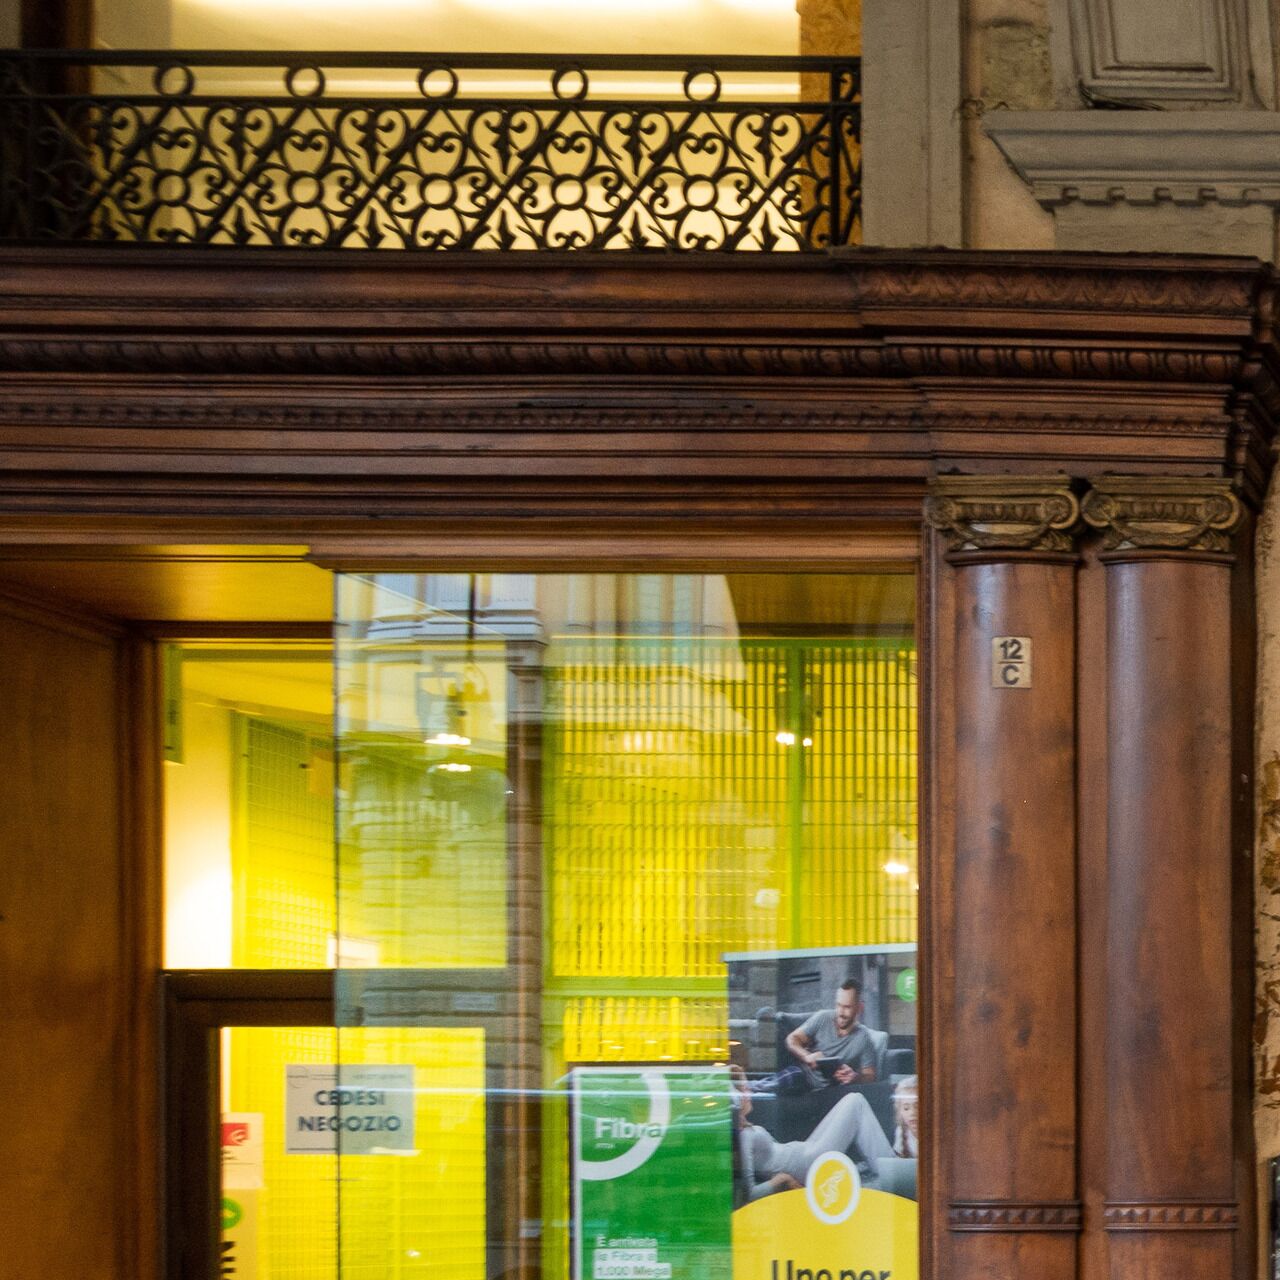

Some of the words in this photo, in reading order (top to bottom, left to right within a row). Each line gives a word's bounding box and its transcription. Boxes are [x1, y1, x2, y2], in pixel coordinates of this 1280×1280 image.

[998, 639, 1023, 660] 12
[1002, 665, 1019, 685] C
[314, 1089, 387, 1106] CEDESI
[297, 1115, 402, 1132] NEGOZIO
[594, 1117, 663, 1139] Fibra
[633, 1265, 669, 1278] Mega
